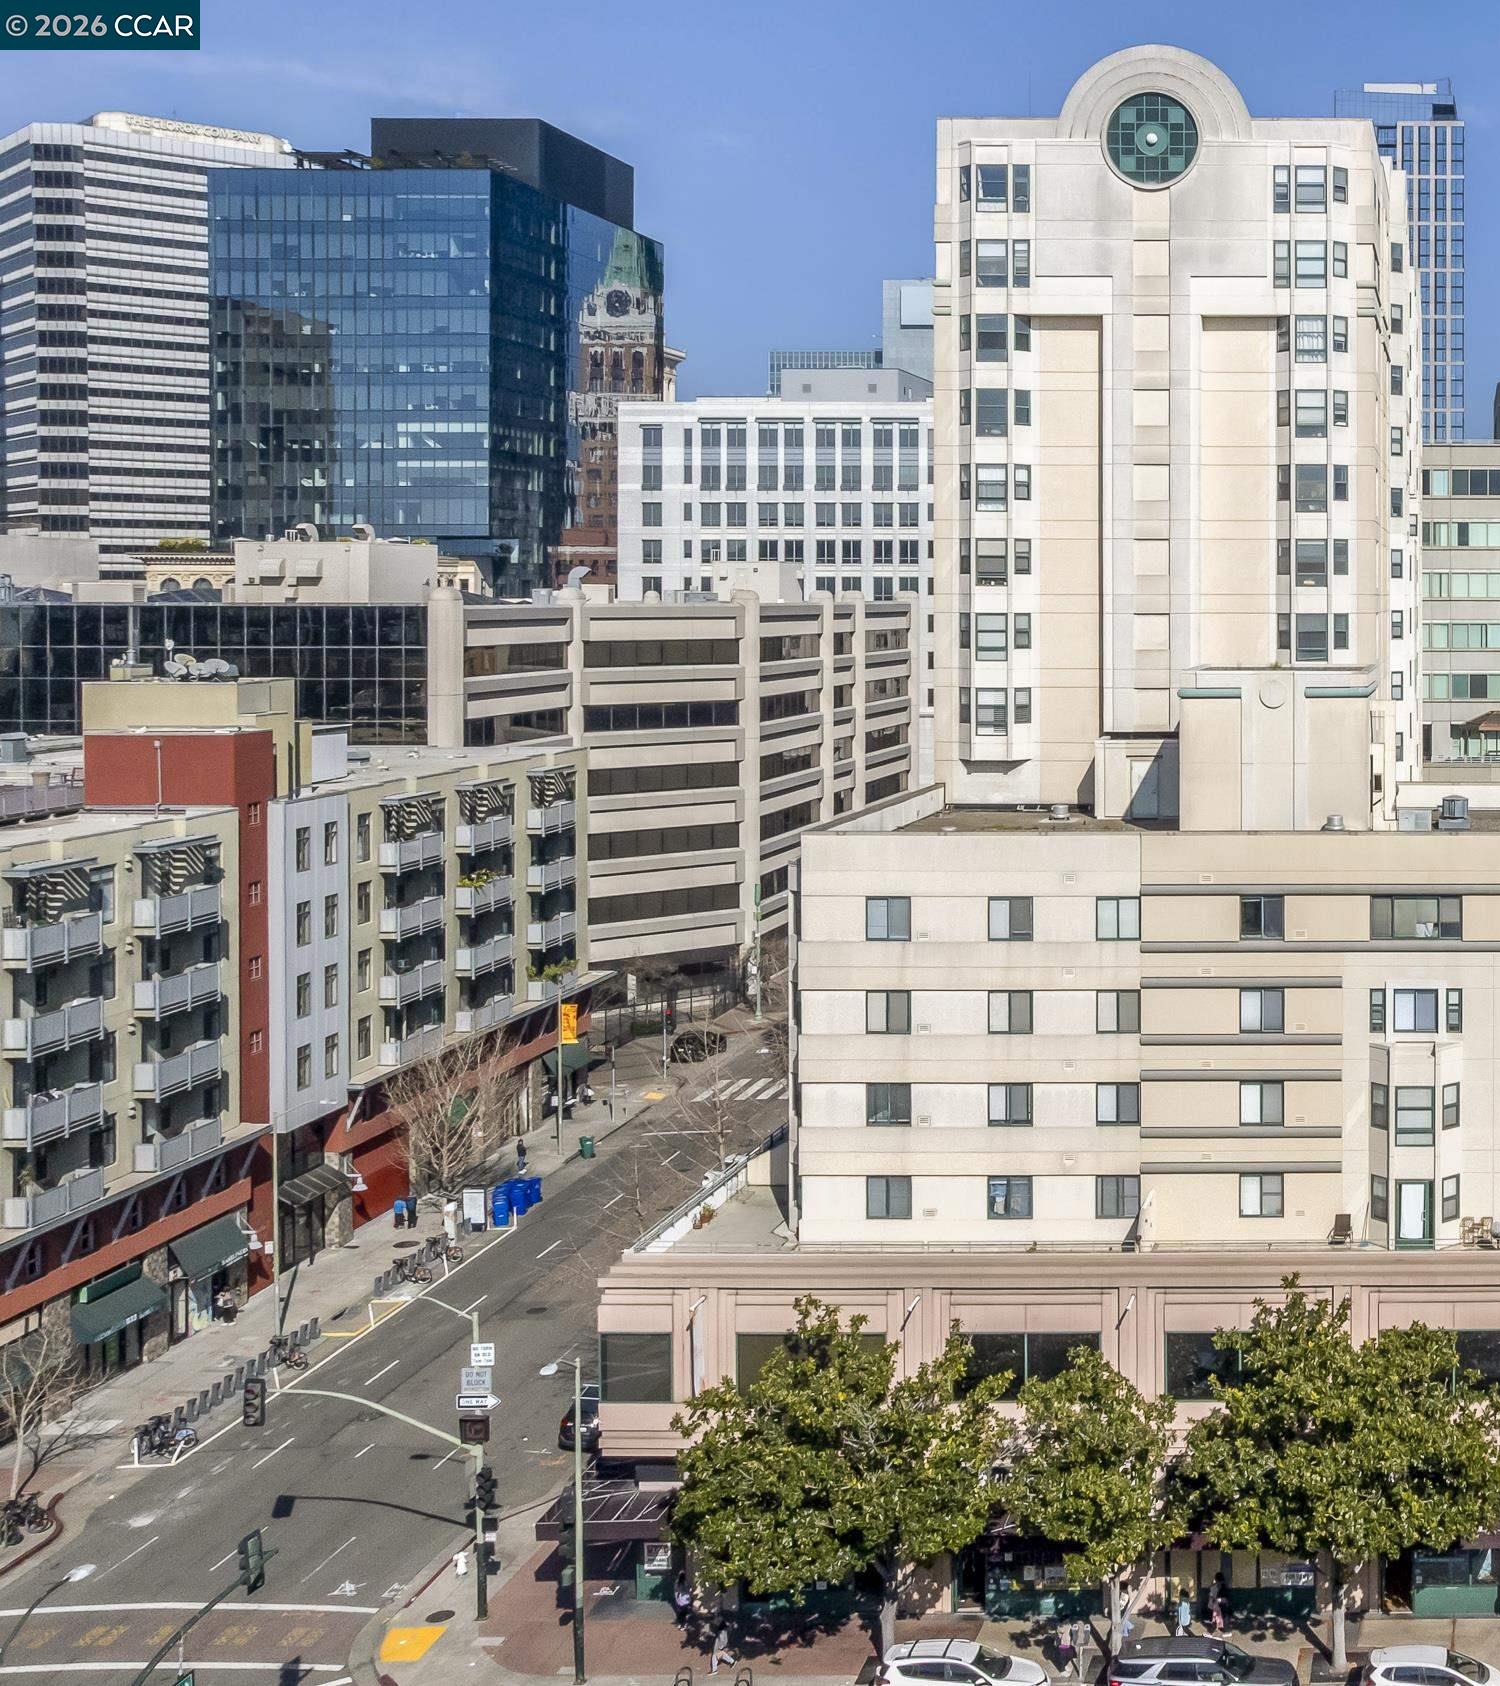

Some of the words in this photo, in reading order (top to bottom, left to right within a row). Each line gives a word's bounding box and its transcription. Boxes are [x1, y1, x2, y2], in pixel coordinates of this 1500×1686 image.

[125, 115, 151, 129] THE
[152, 118, 202, 136] CLOROX
[203, 125, 262, 145] COMPANY
[466, 1379, 486, 1387] BLOCK
